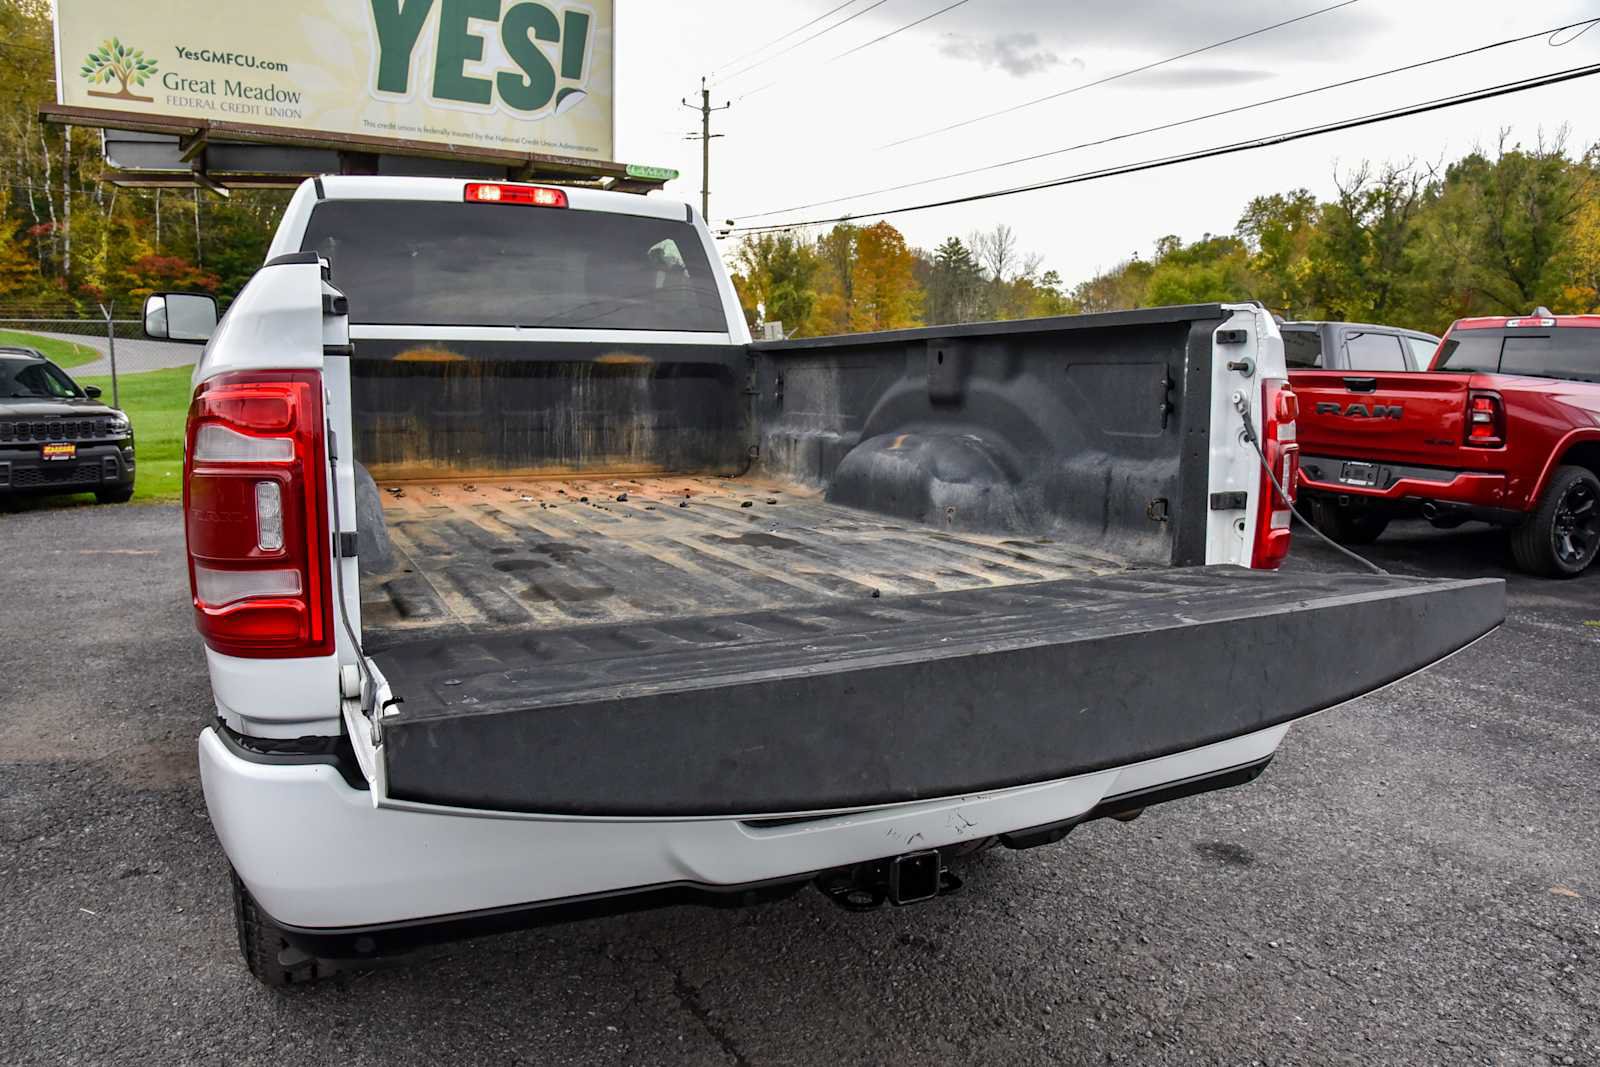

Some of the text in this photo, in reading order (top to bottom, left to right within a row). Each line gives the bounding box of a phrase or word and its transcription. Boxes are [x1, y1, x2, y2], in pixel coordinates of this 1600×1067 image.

[175, 46, 288, 72] YesGMFCU.com
[371, 0, 590, 111] YES!
[162, 72, 302, 104] Great Meadow
[166, 95, 302, 119] FEDERAL CREDIT UNION
[363, 119, 377, 129] This
[377, 121, 396, 130] credit
[397, 124, 416, 132] union
[424, 125, 450, 137] federally
[452, 130, 474, 139] insured
[475, 131, 483, 141] by
[496, 135, 520, 144] National
[521, 137, 539, 146] Credit
[541, 139, 557, 147] Union
[1315, 401, 1403, 419] RAM
